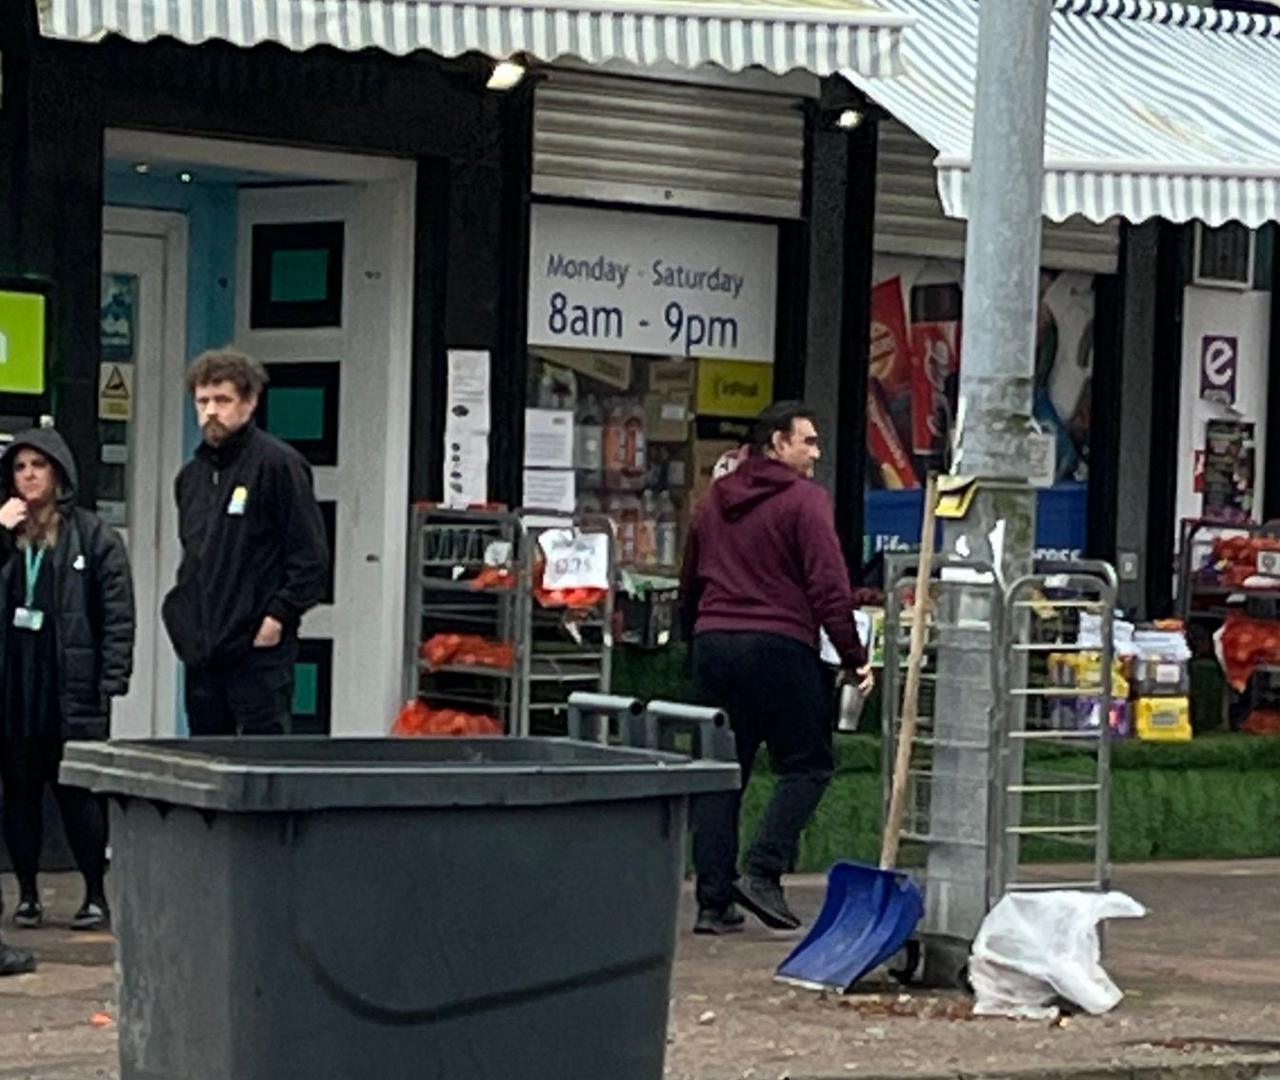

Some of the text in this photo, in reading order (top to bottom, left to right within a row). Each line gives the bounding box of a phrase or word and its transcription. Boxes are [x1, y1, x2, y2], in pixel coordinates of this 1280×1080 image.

[547, 253, 629, 289] Monday
[652, 259, 744, 299] Saturday
[548, 291, 622, 338] 8am
[664, 300, 738, 356] 9pm
